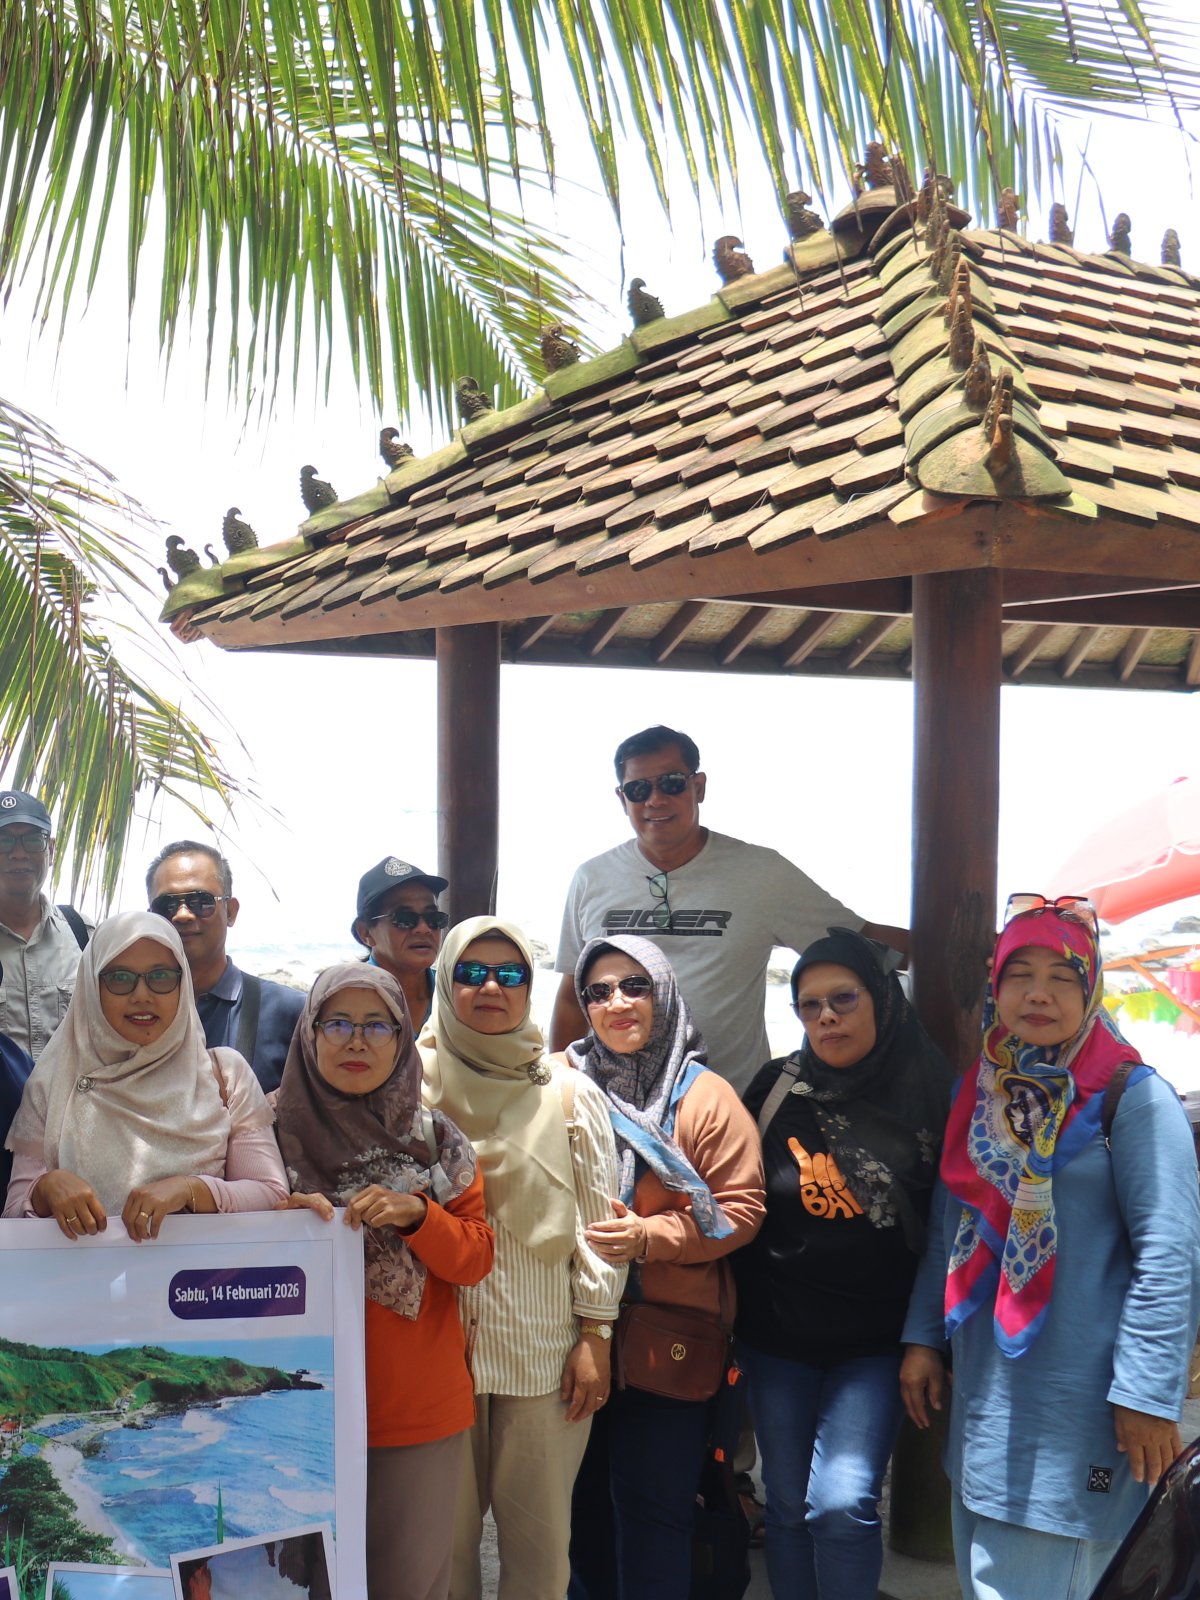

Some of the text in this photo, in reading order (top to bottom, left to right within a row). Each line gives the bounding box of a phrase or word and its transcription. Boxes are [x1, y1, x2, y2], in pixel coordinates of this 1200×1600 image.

[601, 909, 733, 929] EIGER
[174, 1282, 300, 1304] Sabtu, 14 Februari 2026
